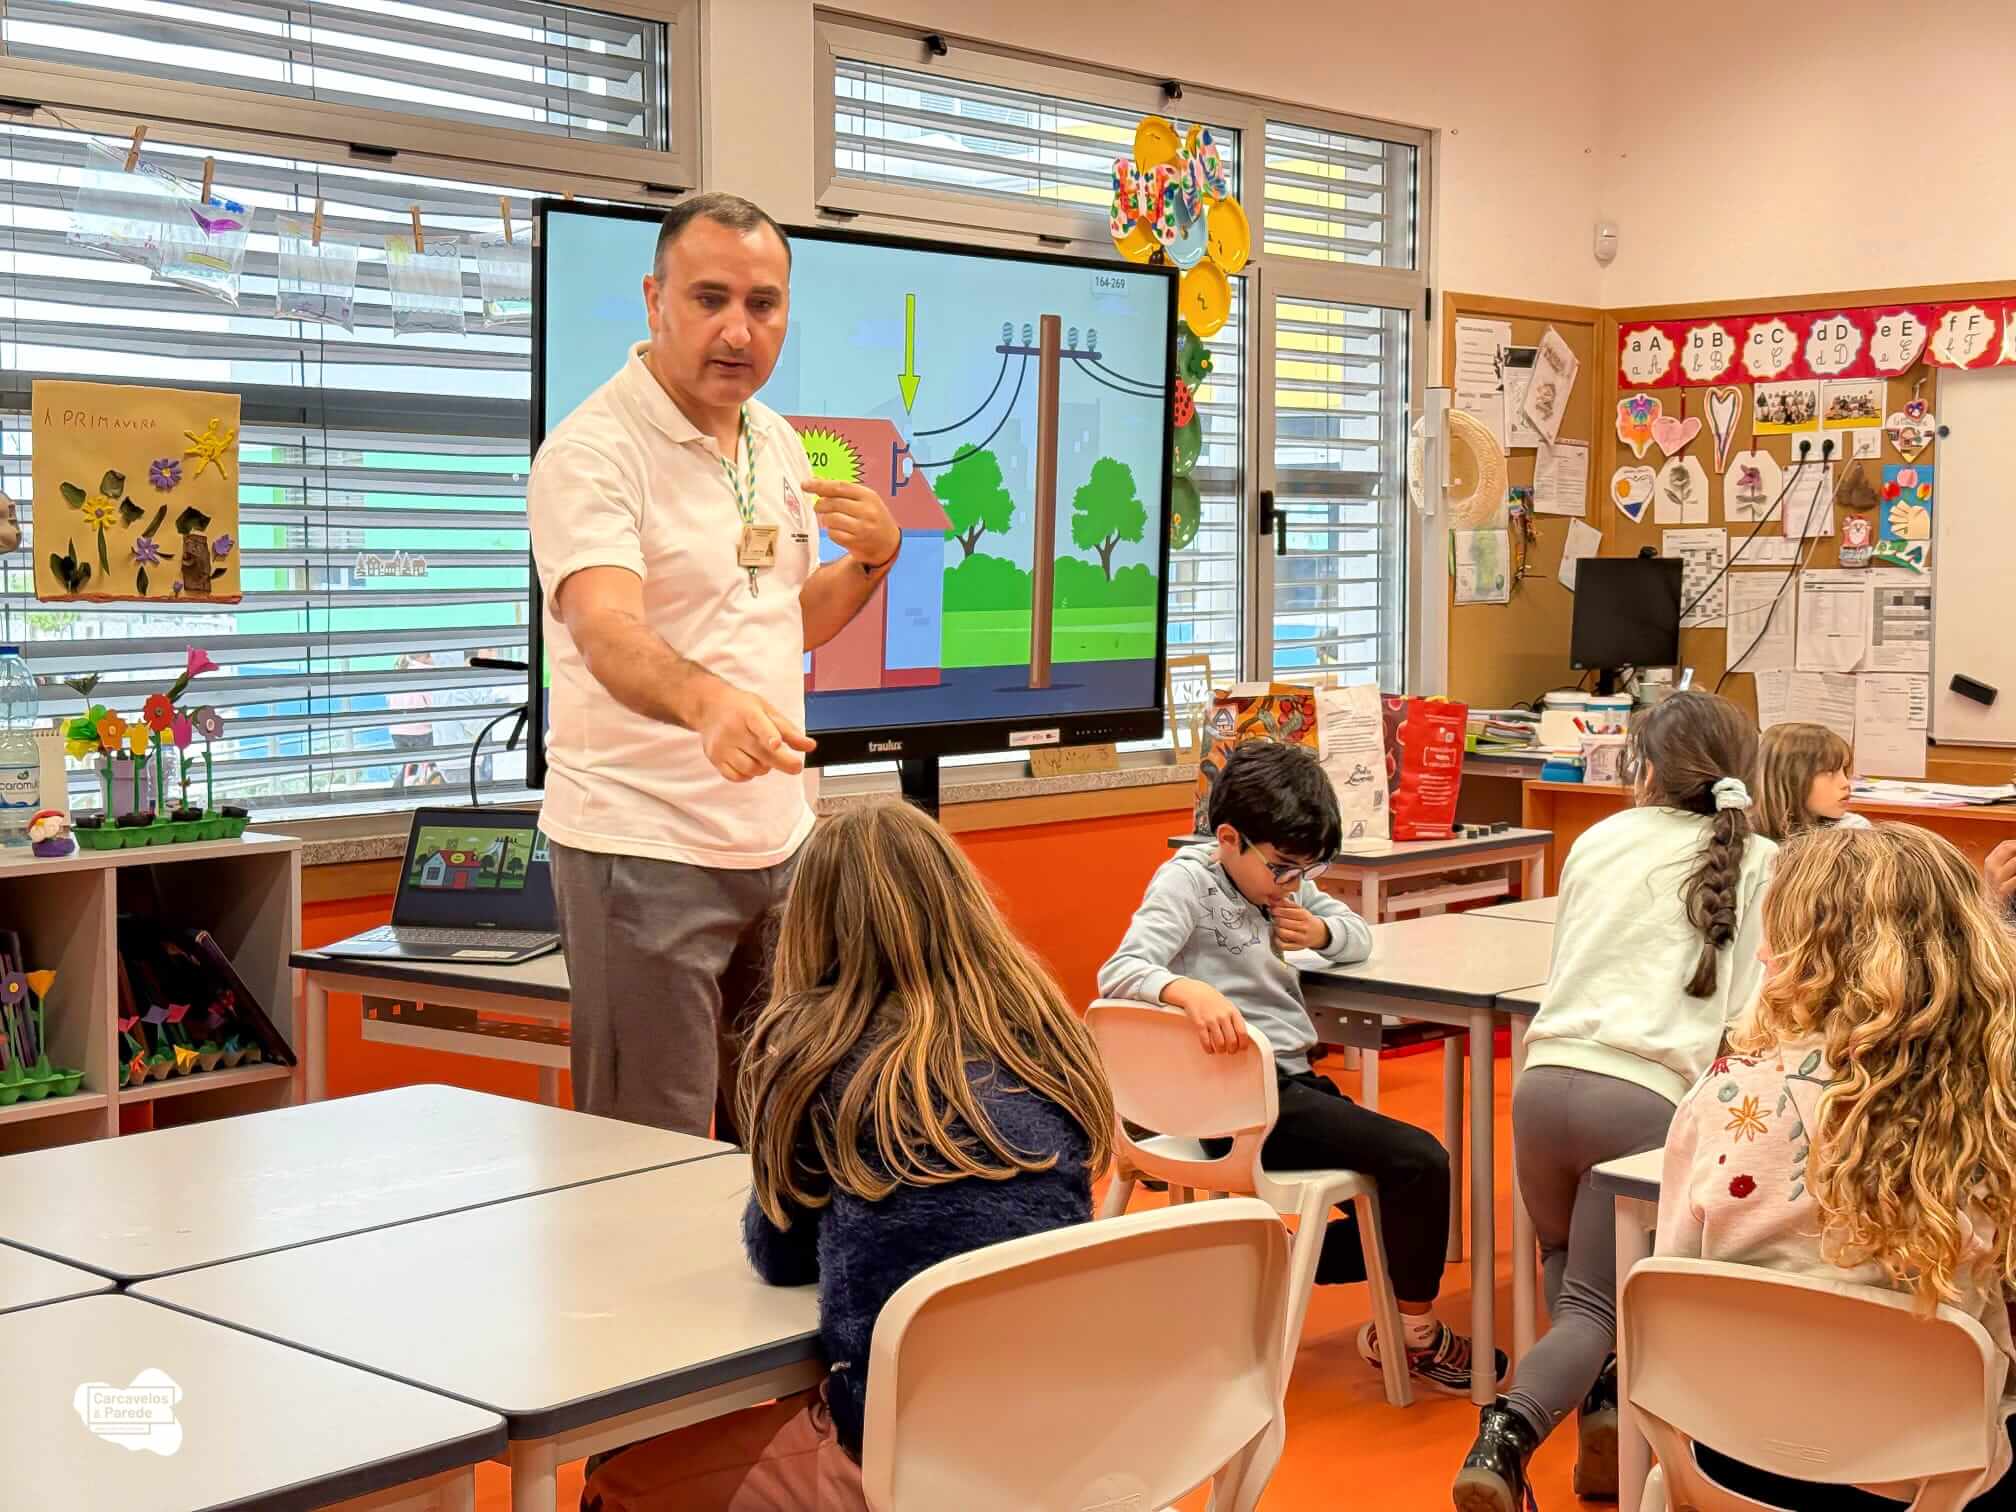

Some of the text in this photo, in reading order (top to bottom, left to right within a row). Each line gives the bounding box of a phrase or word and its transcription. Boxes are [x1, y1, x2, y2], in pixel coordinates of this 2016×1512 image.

[1095, 276, 1126, 289] 164-269
[1880, 320, 1913, 337] e E
[1949, 315, 1981, 332] f F
[1694, 332, 1723, 349] b B
[1753, 328, 1784, 345] c C
[1816, 324, 1848, 341] d D
[1632, 336, 1662, 352] a A
